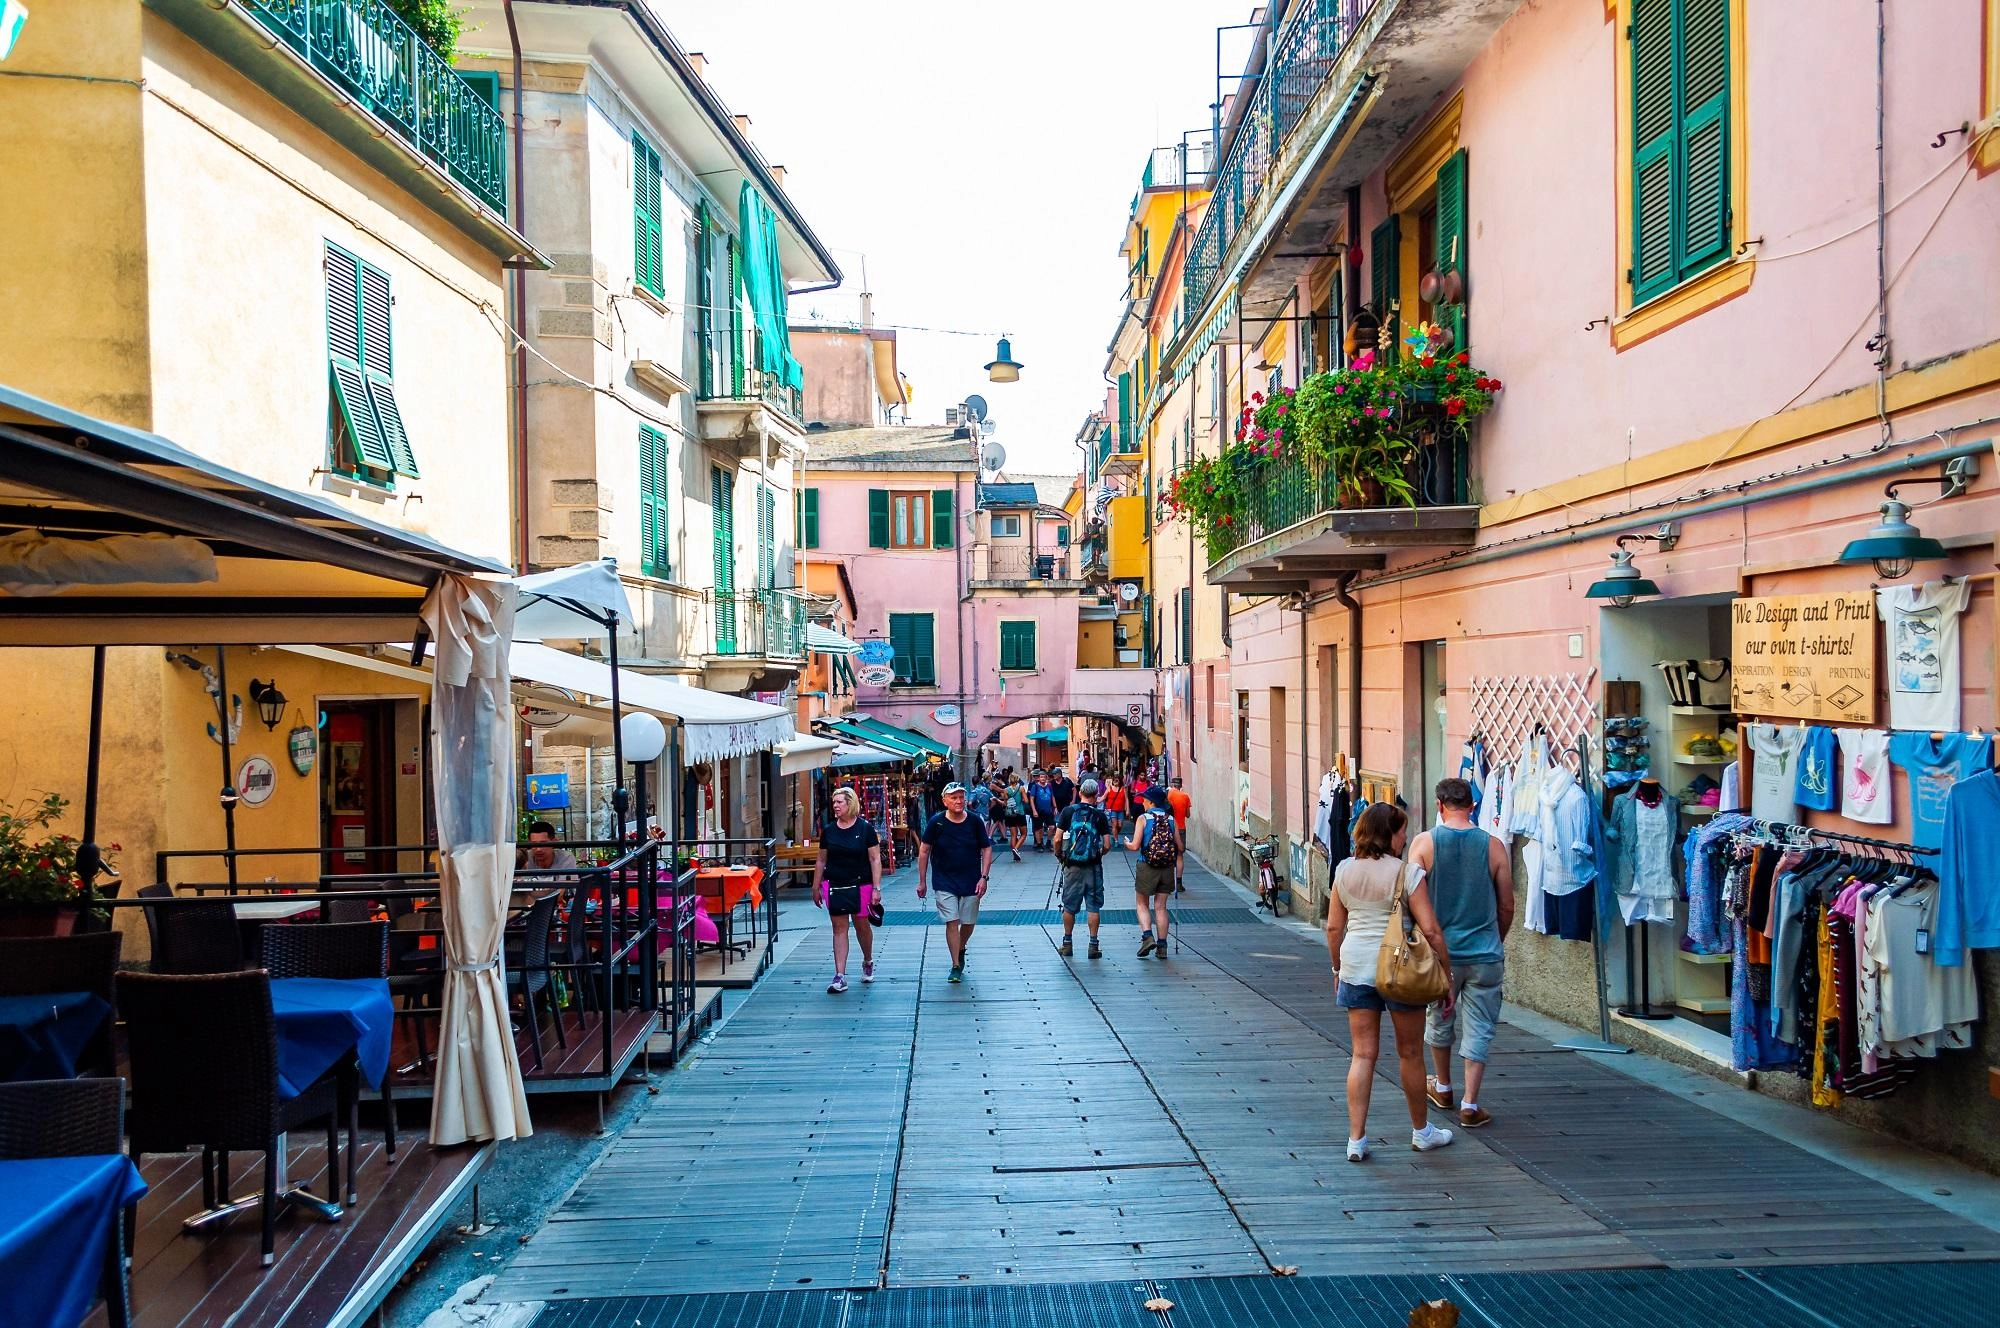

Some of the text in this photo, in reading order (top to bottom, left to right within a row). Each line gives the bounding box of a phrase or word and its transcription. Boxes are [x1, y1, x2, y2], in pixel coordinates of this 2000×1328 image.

[1733, 598, 1871, 632] We Design and Print
[1745, 633, 1855, 656] our own t-shirts!
[1733, 665, 1871, 679] INSPIRATION DESIGN PRINTING
